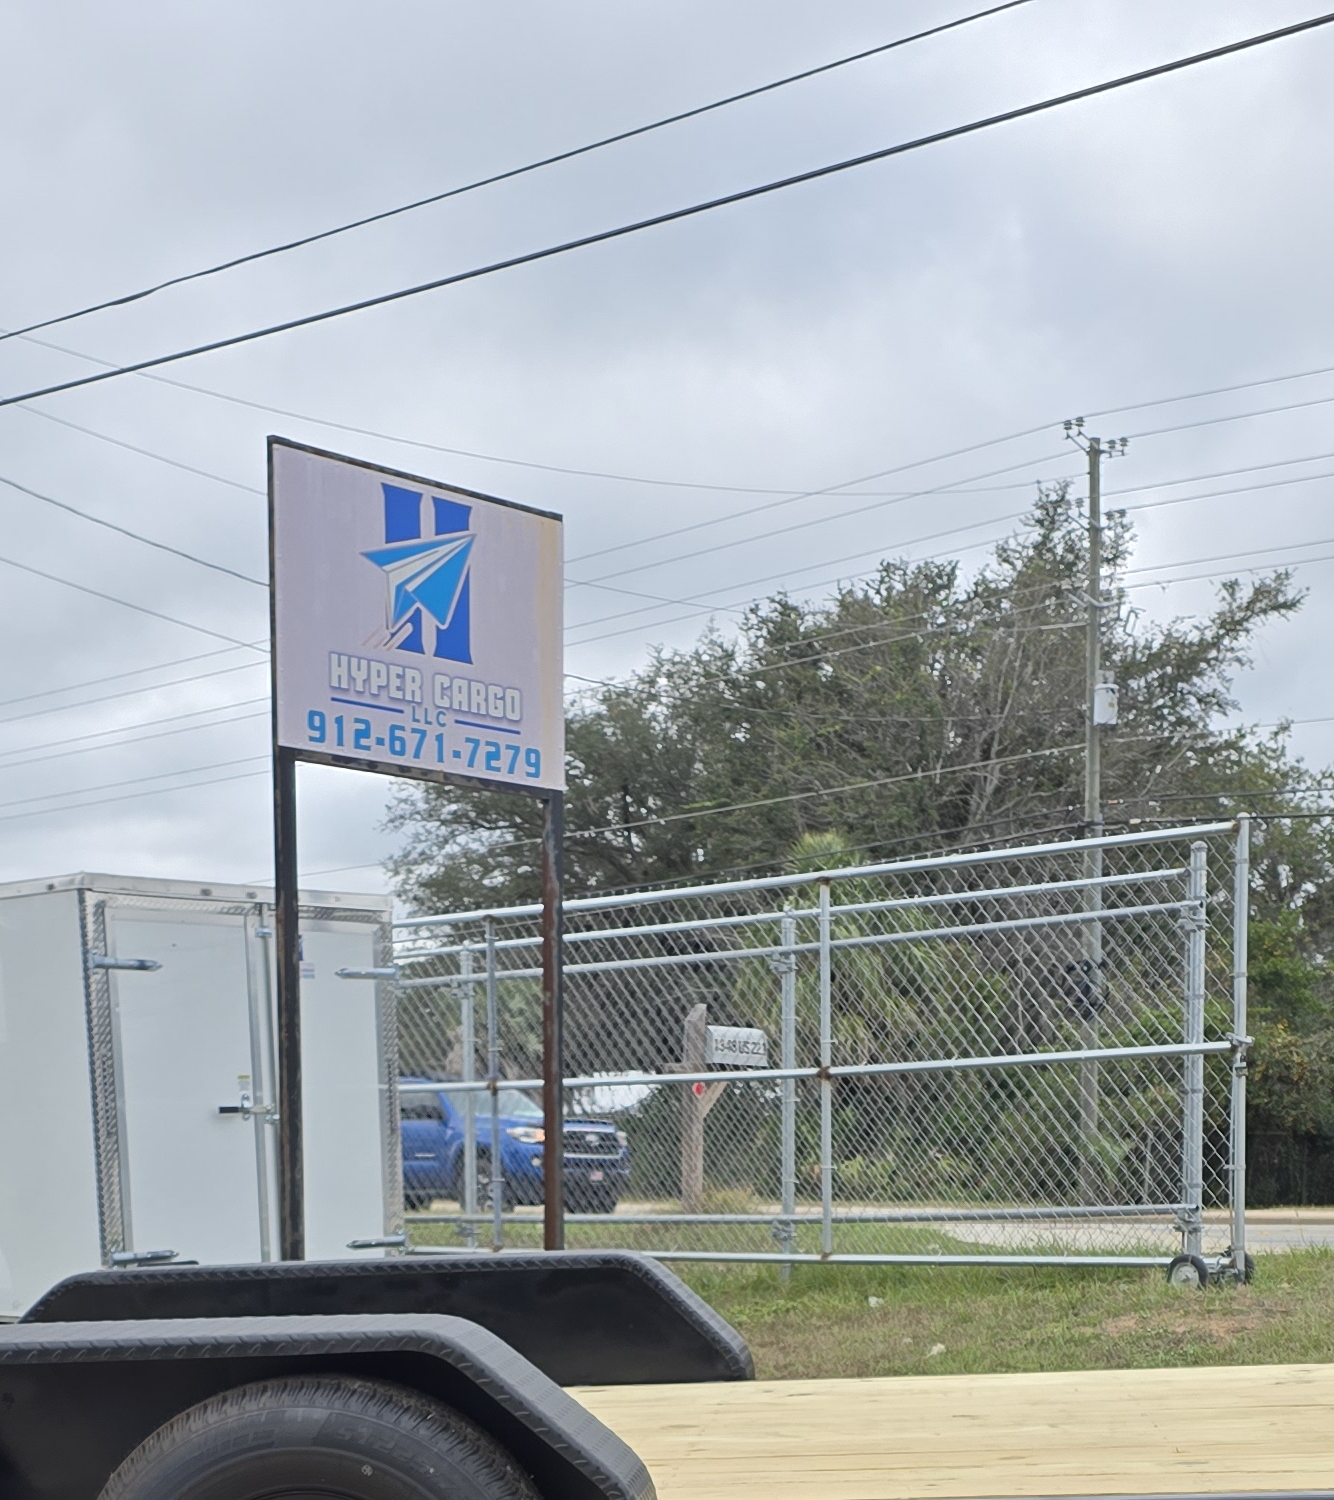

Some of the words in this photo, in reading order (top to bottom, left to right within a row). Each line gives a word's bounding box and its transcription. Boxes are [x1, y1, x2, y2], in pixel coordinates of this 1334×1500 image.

[329, 652, 423, 704] HYPER
[433, 673, 522, 722] CARGO
[411, 705, 447, 728] LLC
[307, 709, 541, 779] 912-671-7279
